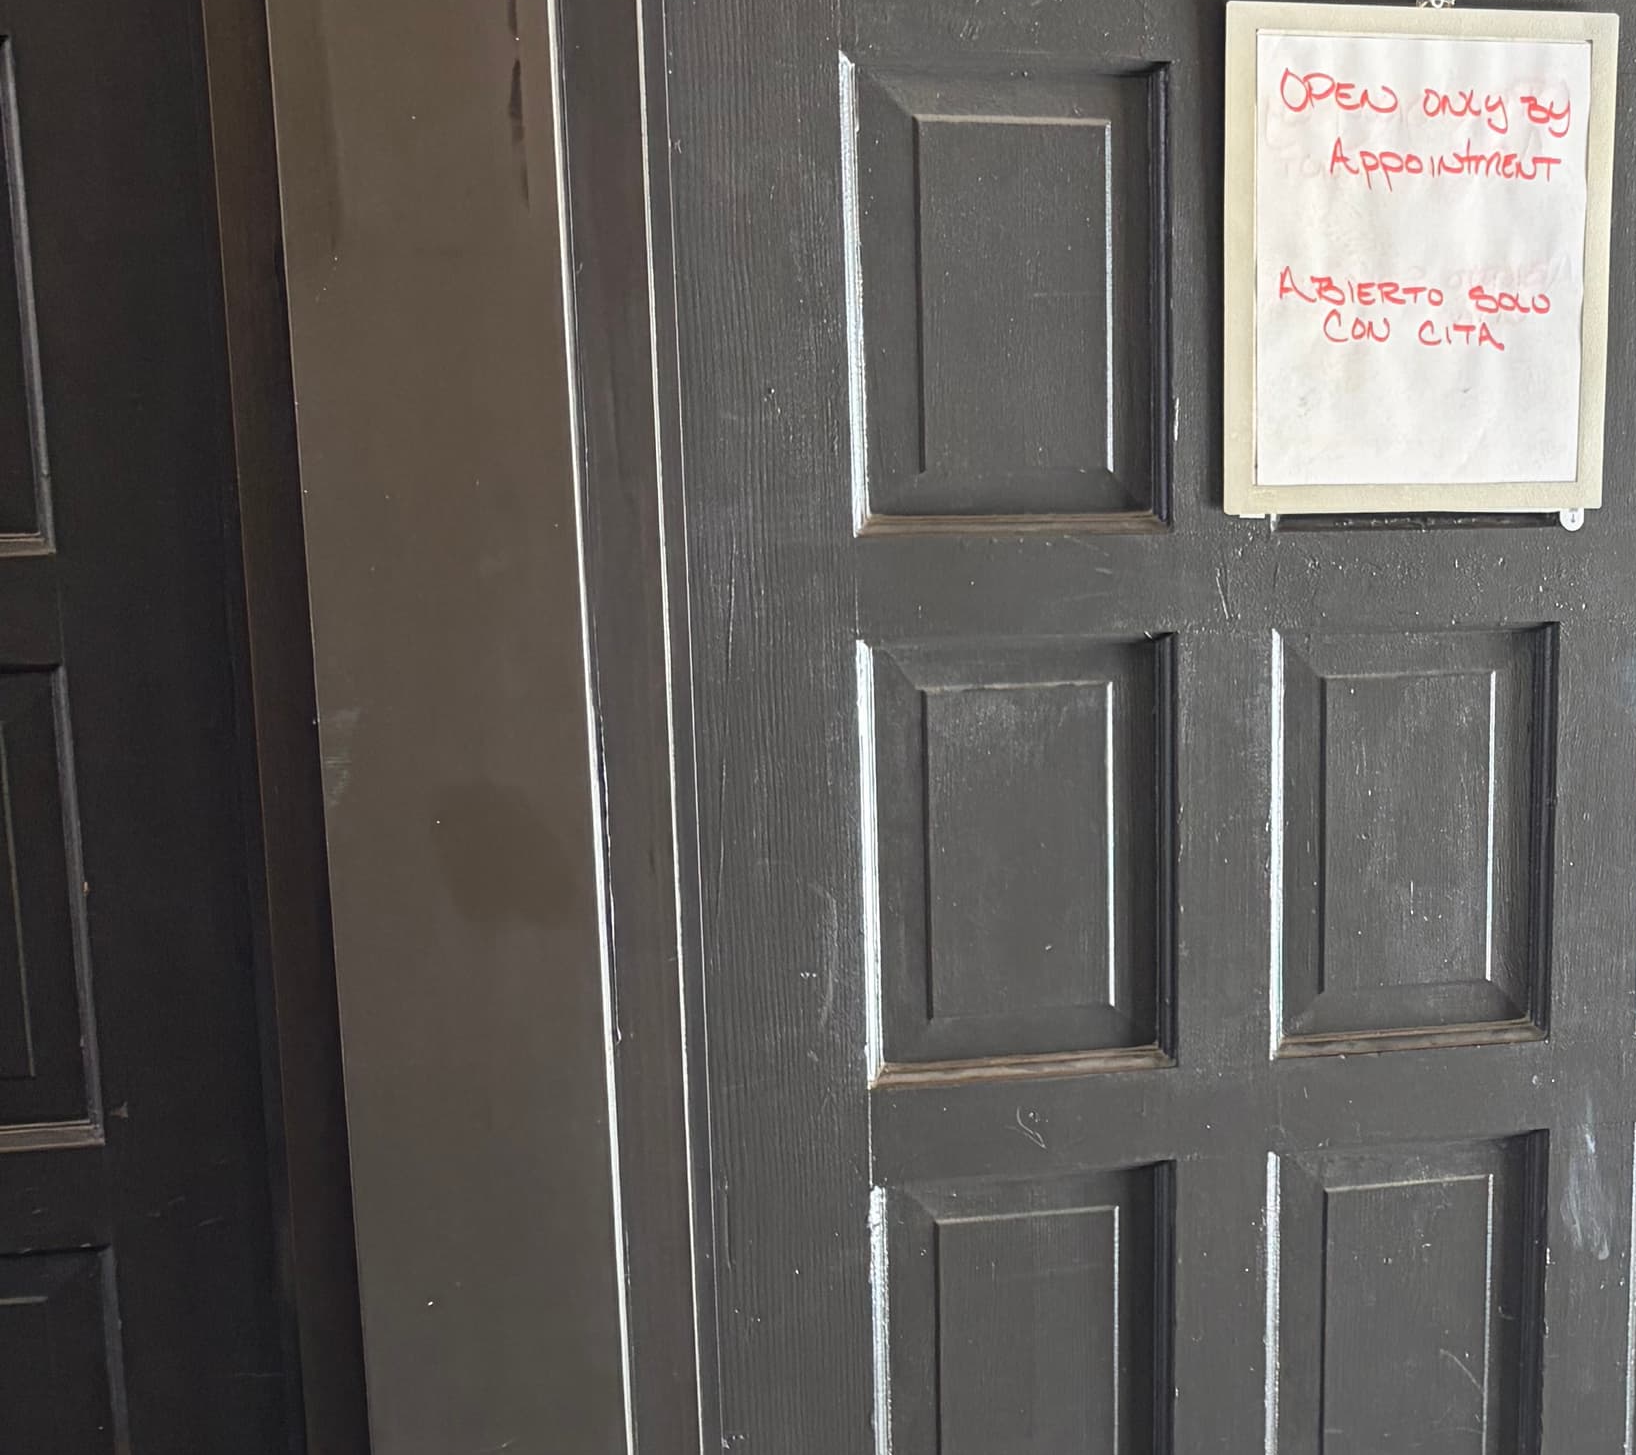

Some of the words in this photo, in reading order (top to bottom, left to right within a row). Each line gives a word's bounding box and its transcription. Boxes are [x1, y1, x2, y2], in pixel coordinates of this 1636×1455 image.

[1280, 67, 1398, 113] OPEN
[1279, 265, 1444, 306] ABIERTO
[1468, 285, 1551, 314] SOLO
[1323, 308, 1391, 343] CON
[1417, 320, 1506, 351] CITA
